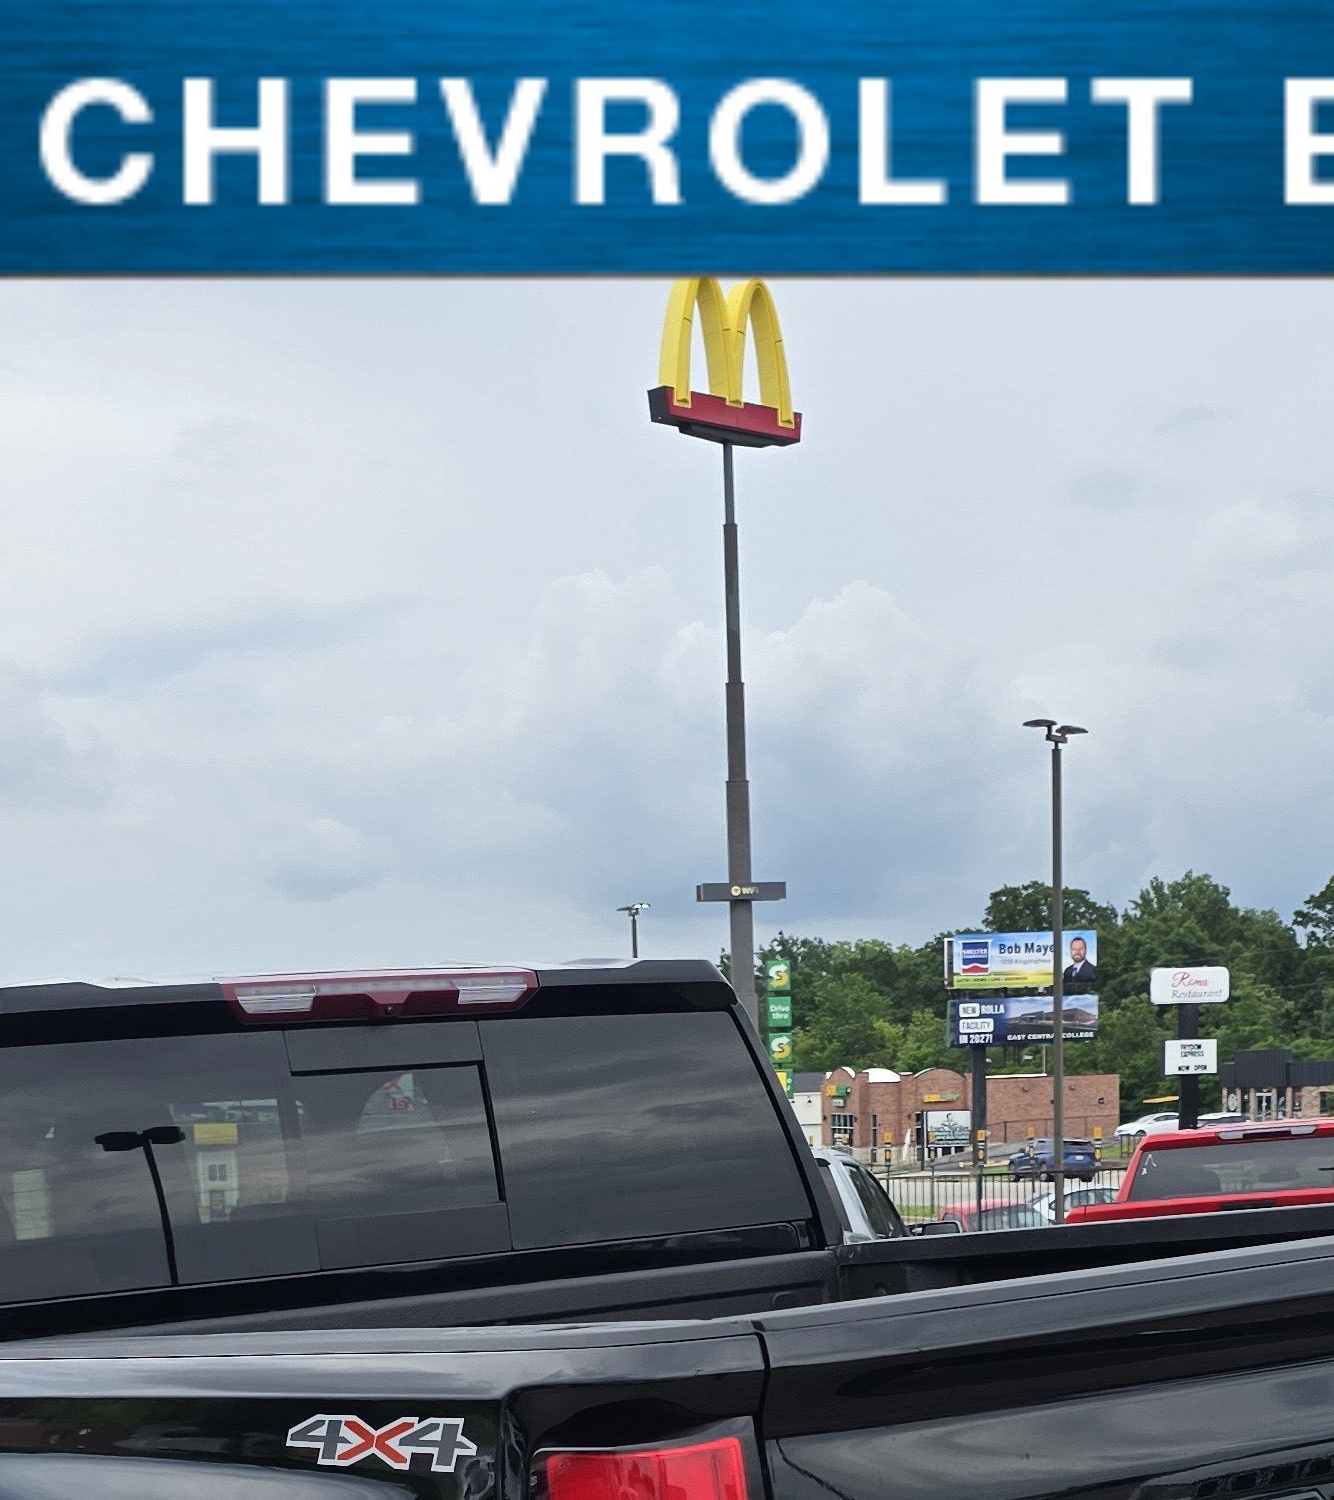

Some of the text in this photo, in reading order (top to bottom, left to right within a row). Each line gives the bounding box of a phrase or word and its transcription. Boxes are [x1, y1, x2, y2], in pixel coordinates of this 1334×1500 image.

[999, 943, 1021, 955] Bob
[1172, 989, 1223, 999] Restaurant
[962, 1004, 1005, 1015] NEW ROLLA
[1062, 1031, 1094, 1039] COLLEGE
